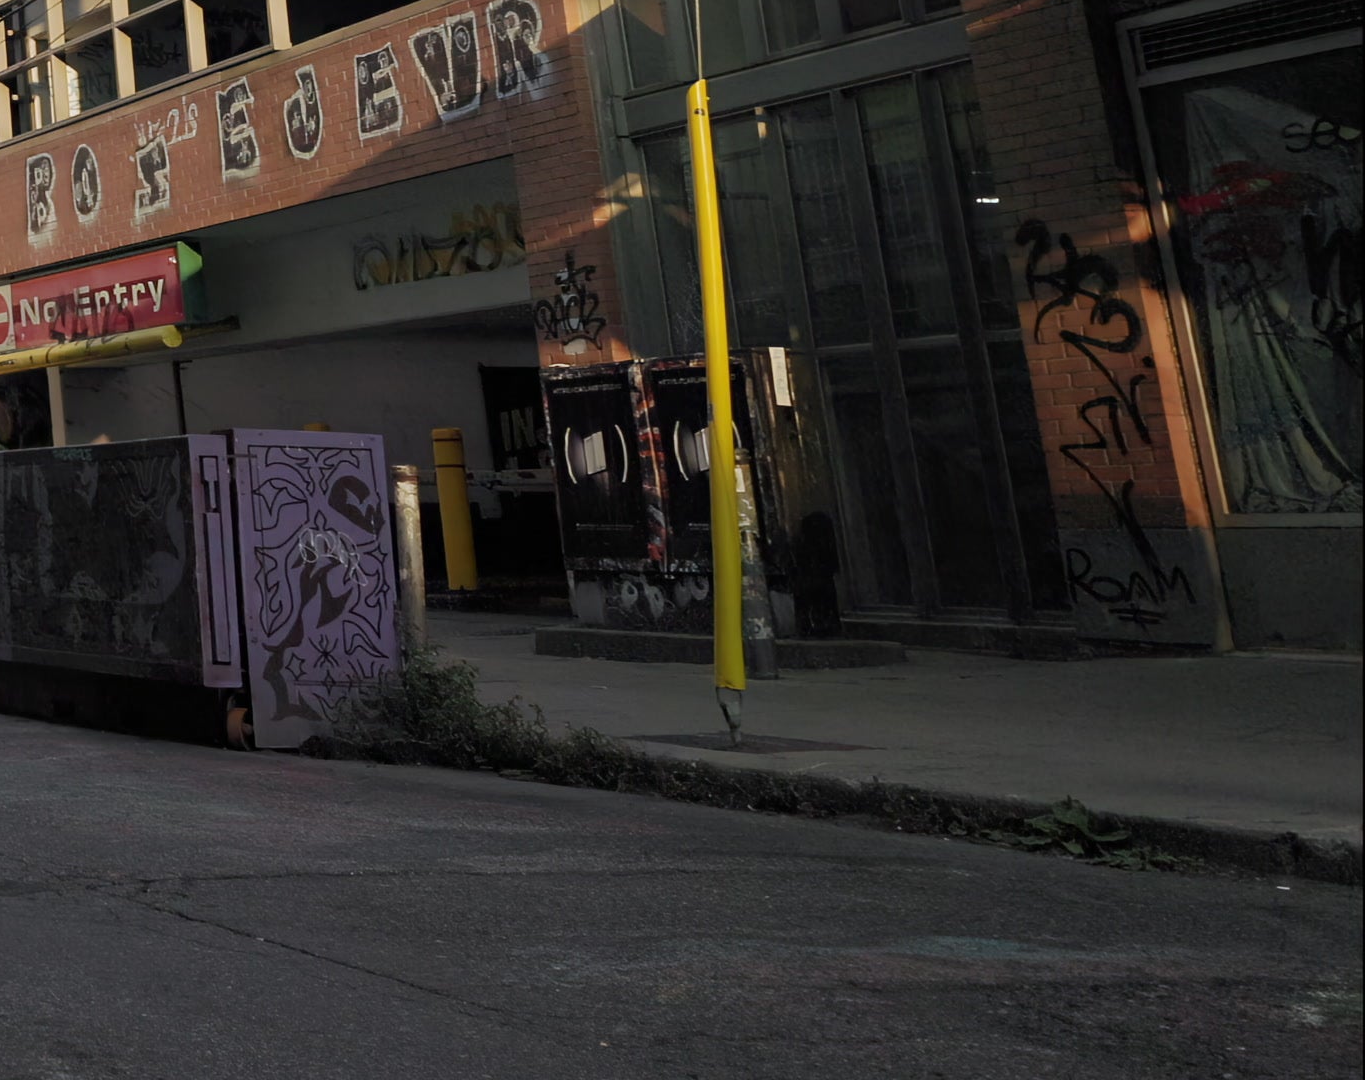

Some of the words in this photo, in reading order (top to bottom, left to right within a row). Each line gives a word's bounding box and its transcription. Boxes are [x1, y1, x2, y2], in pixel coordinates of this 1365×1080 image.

[19, 297, 59, 327] No
[74, 278, 165, 316] Entry
[500, 407, 535, 451] IN
